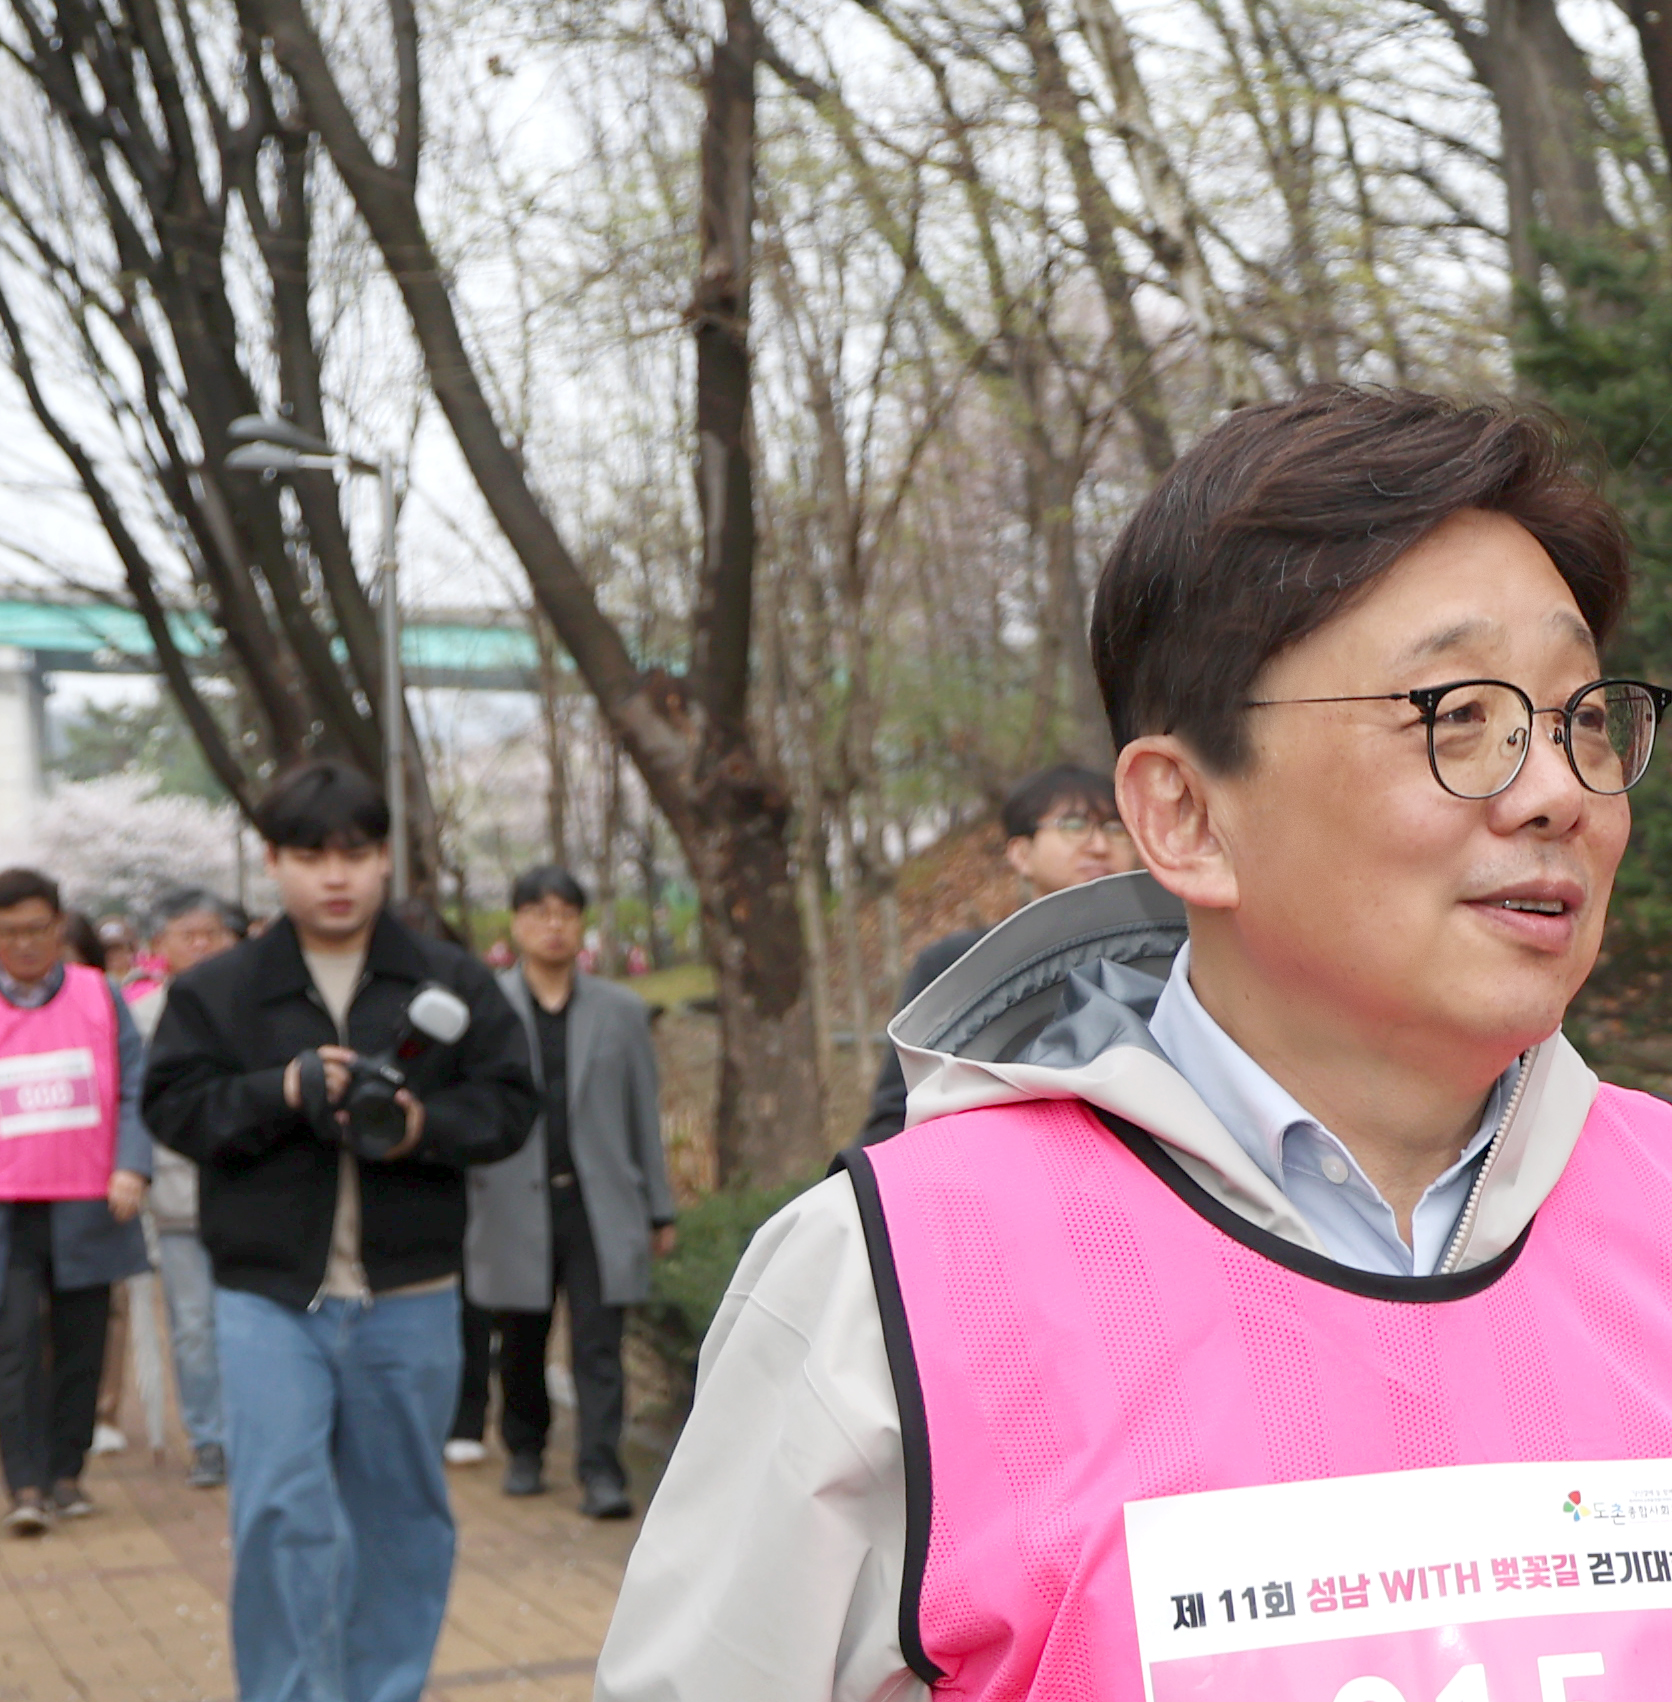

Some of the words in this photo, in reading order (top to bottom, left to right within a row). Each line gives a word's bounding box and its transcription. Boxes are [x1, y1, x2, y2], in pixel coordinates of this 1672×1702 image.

[1594, 1502, 1626, 1525] 도촌
[1171, 1593, 1206, 1631] 제
[1218, 1581, 1296, 1623] 11회
[1307, 1574, 1370, 1612] 성남
[1379, 1561, 1480, 1602] WITH
[1491, 1554, 1580, 1591] 벚꽃길
